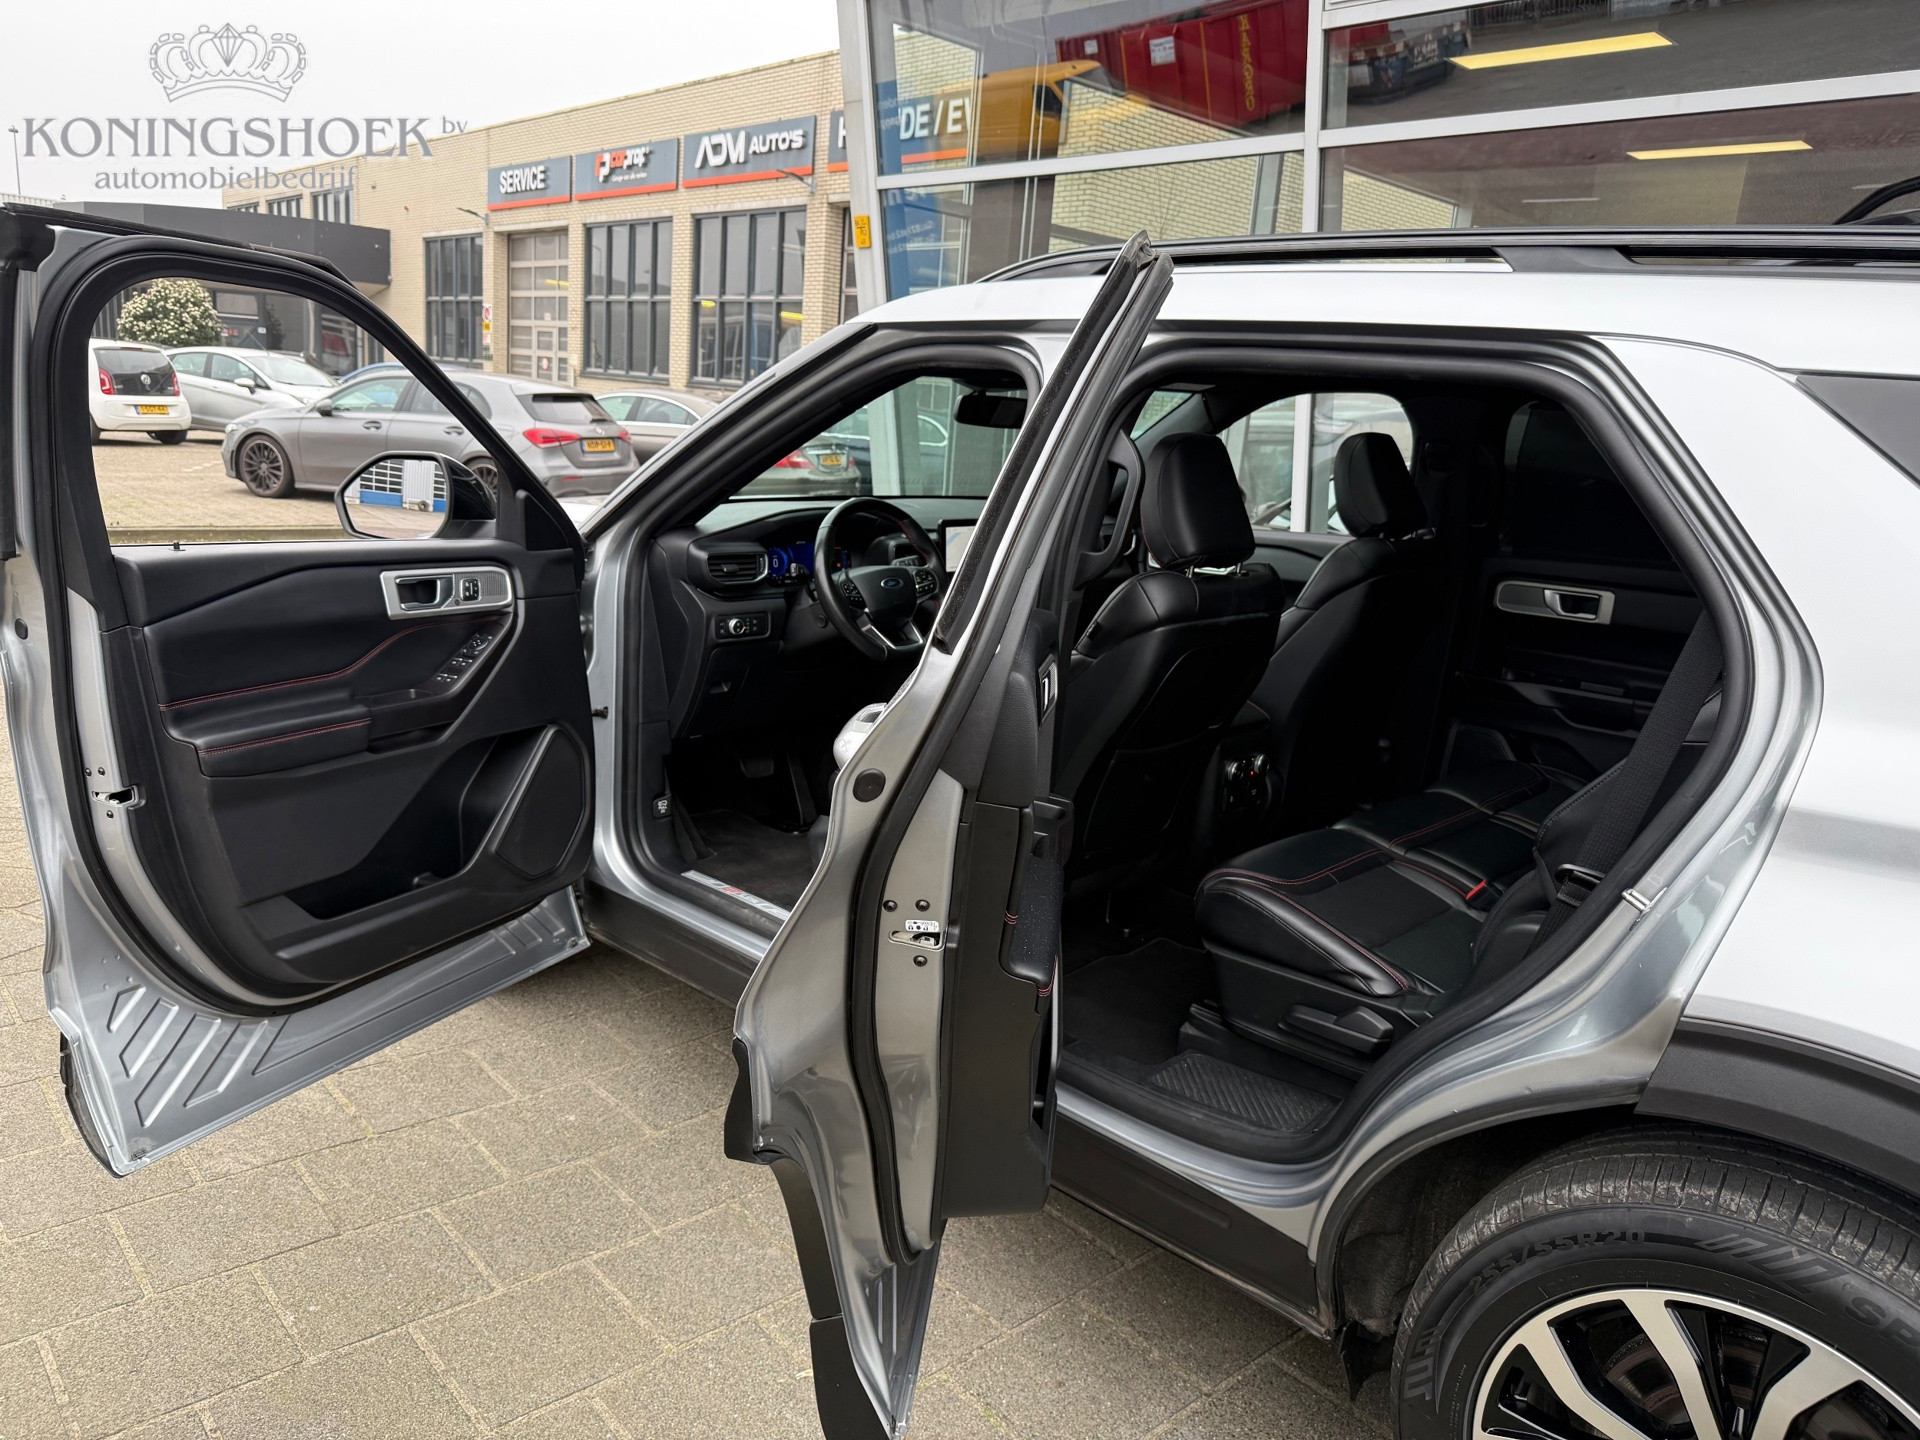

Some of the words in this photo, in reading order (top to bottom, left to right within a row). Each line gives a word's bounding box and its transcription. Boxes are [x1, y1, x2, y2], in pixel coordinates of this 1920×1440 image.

[748, 128, 805, 155] AUTO'S
[499, 164, 546, 194] SERVICE
[1467, 1228, 1645, 1295] 255/55R20
